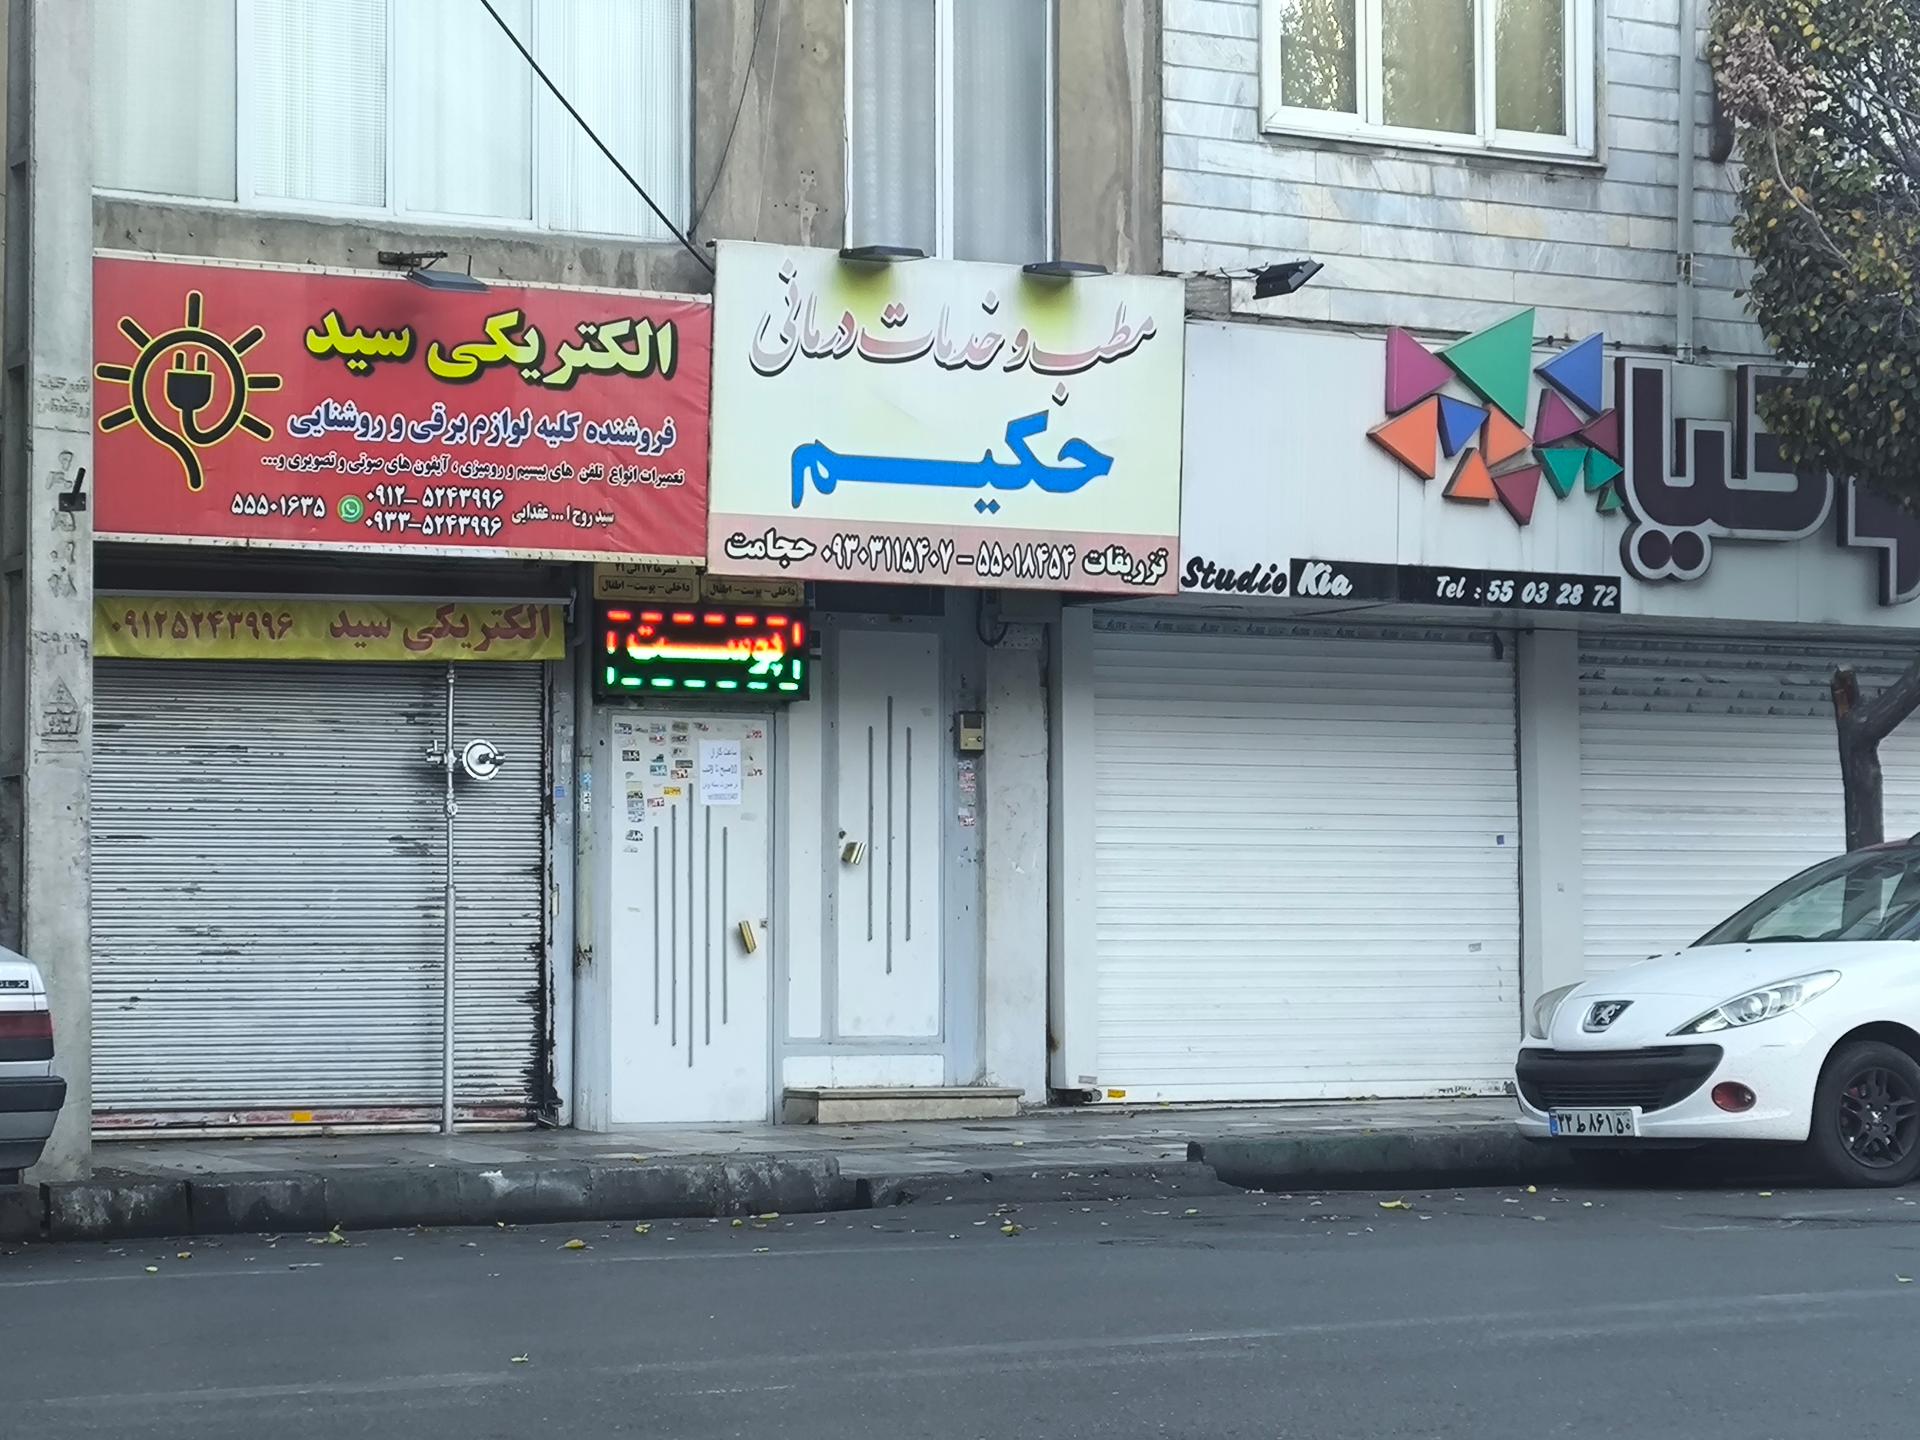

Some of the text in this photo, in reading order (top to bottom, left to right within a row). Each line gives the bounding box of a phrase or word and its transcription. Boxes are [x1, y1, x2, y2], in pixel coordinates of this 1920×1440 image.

[748, 257, 1157, 406] مطب و خدمات درمانی
[304, 308, 677, 389] الکتریکی سید
[287, 398, 677, 455] فروشنده کلیه لوازم برقی و روشنایی
[287, 452, 337, 473] تصویری
[337, 458, 345, 473] و
[347, 452, 384, 474] صوتی
[384, 455, 411, 475] های
[412, 453, 451, 478] آیفون
[506, 465, 515, 479] و
[516, 463, 548, 479] بیسیم
[549, 461, 574, 482] های
[790, 409, 1115, 514] حکیم
[578, 463, 604, 483] تلفن
[608, 466, 638, 487] انواع
[640, 467, 685, 487] تعمیرات
[230, 492, 327, 518] ۵۵۵۰۱۶۳۵
[572, 509, 593, 527] روح
[594, 511, 616, 525] سید
[724, 527, 818, 569] حجامت
[1081, 543, 1169, 586] تزریقات
[1181, 556, 1353, 597] Studio Kia
[1486, 579, 1515, 603] 55
[1521, 581, 1550, 604] 03
[1555, 582, 1585, 606] 28
[1592, 584, 1619, 607] 72
[111, 603, 552, 652] الکتریکی سید ۰۹۱۲۵۲۴۳۹۹۶
